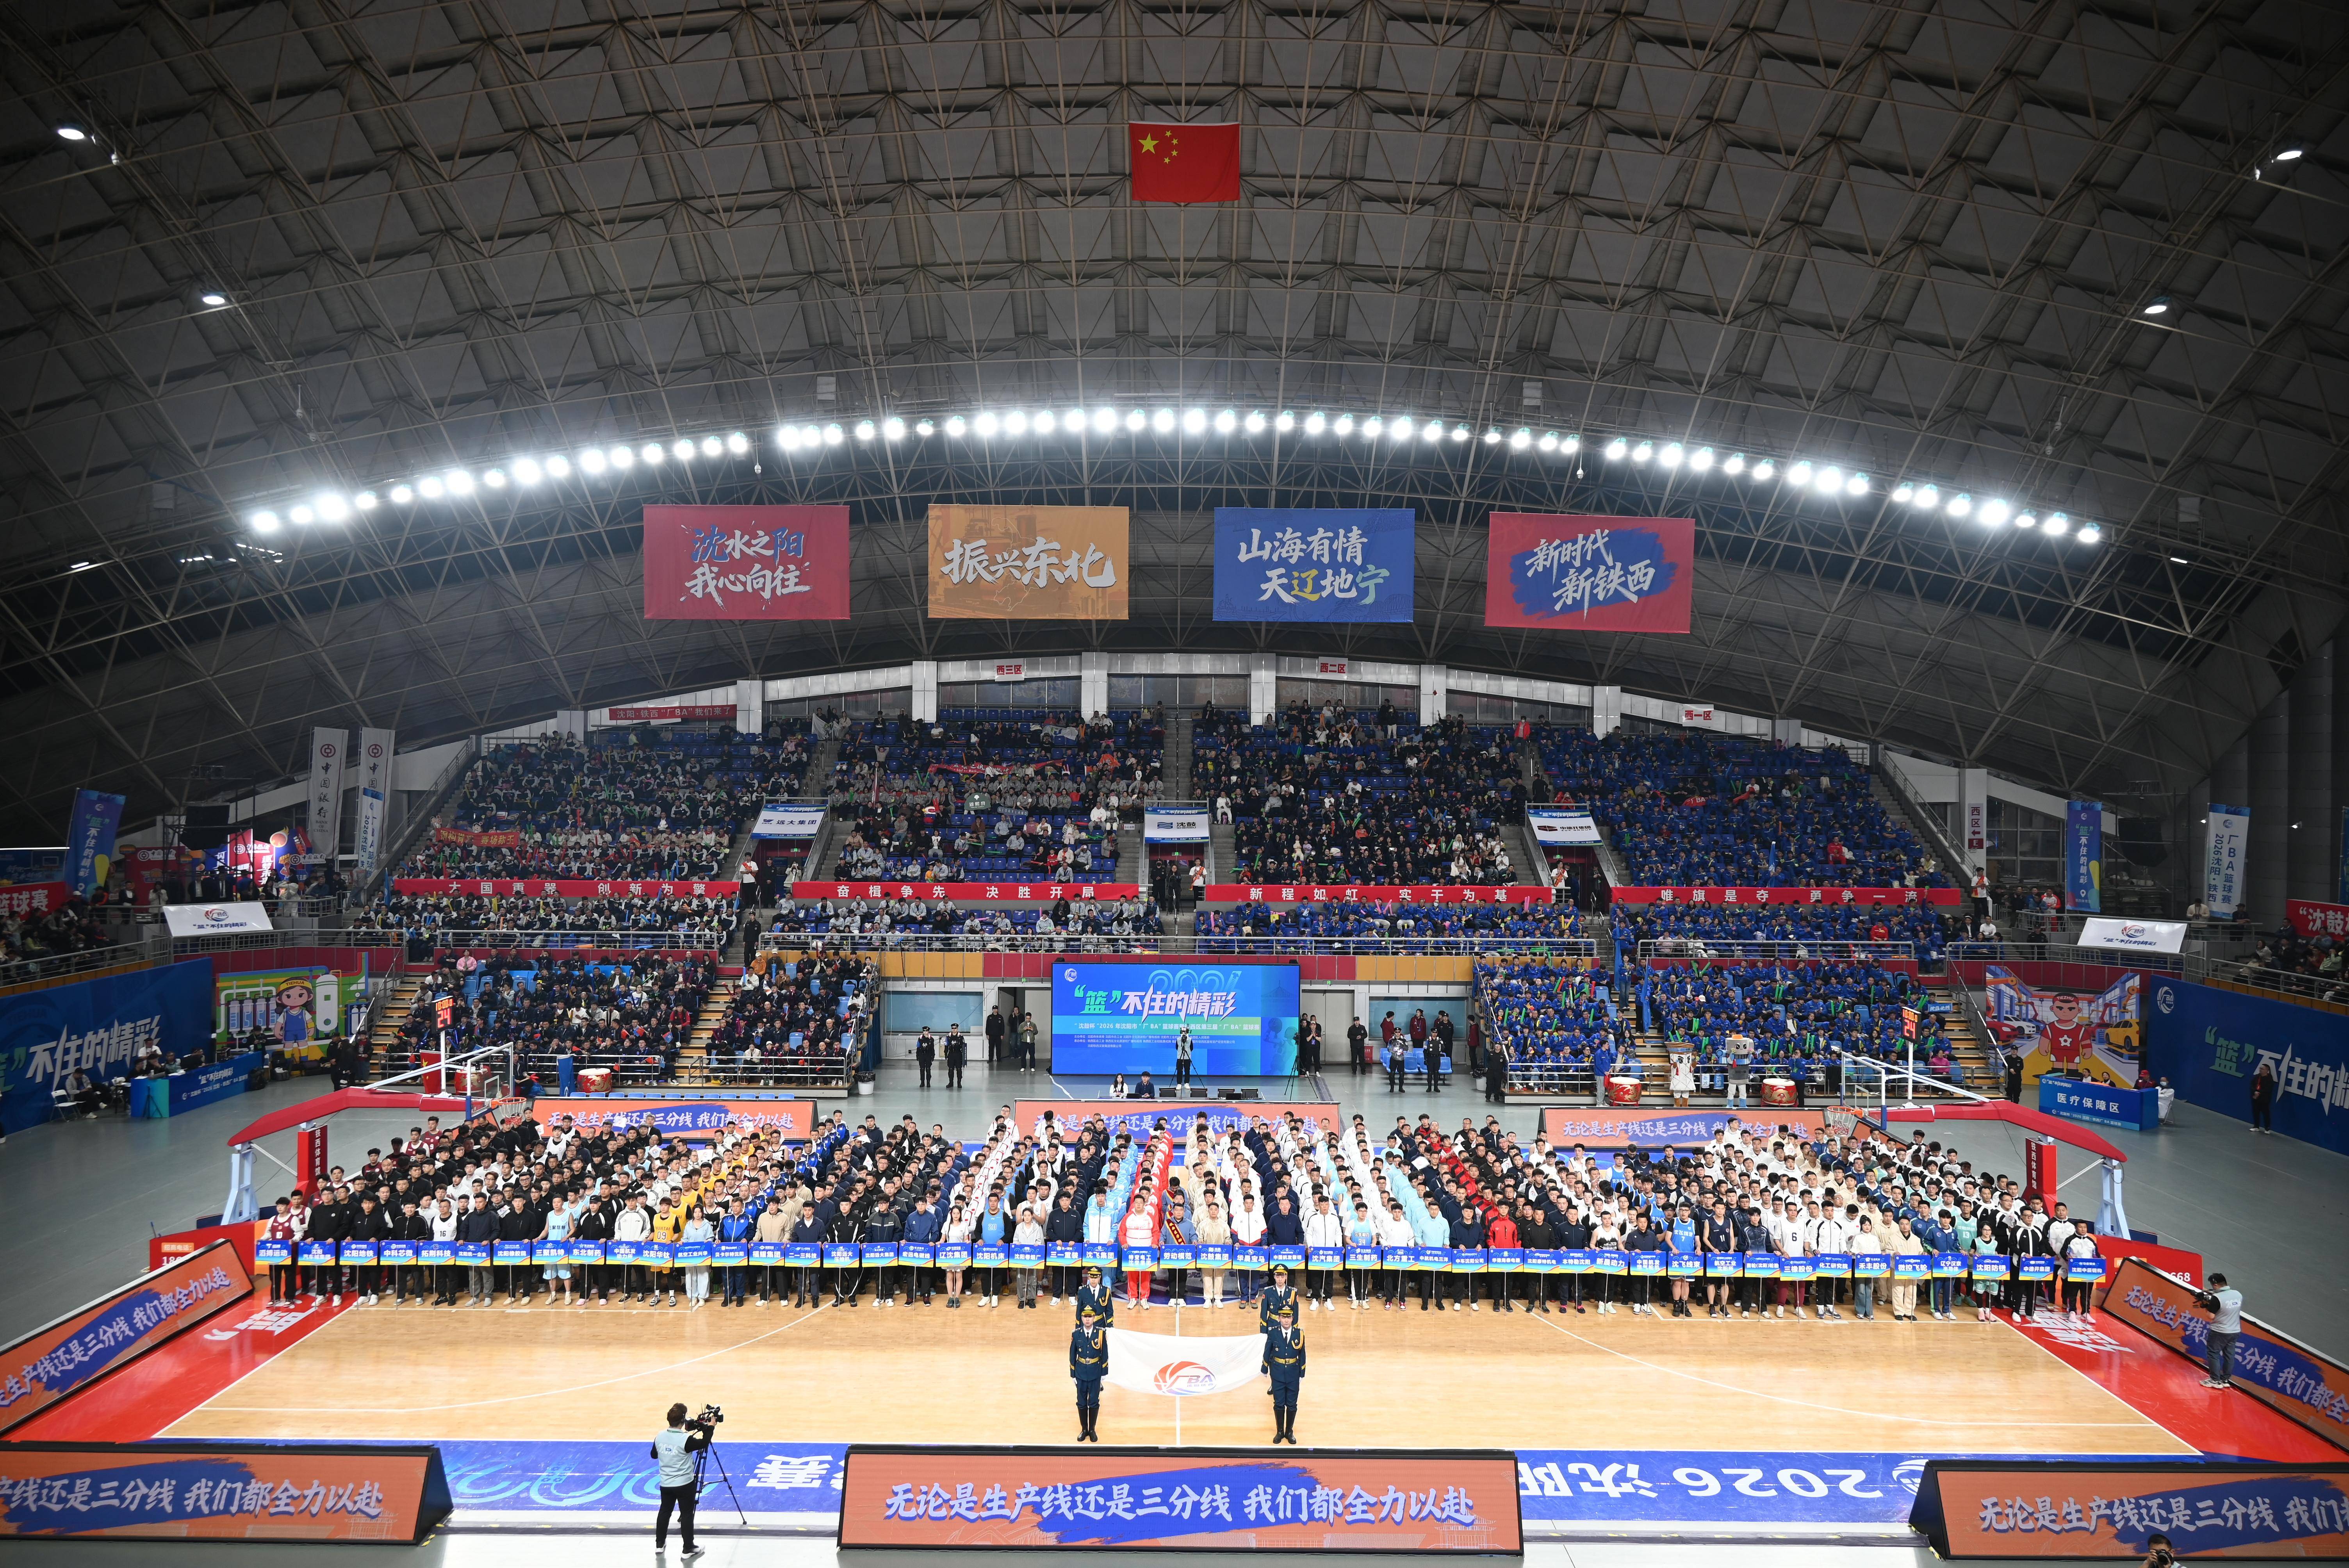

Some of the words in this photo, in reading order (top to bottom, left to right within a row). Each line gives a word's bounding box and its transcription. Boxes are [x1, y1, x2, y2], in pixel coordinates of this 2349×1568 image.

[690, 524, 804, 563] 沈水之阳
[1238, 526, 1369, 565] 山海有情
[941, 536, 1117, 590] 振兴东北
[1525, 528, 1613, 585] 新时代
[684, 563, 813, 612] 我心向往
[1260, 565, 1390, 605] 天辽地宁
[1552, 559, 1656, 620] 新铁西
[996, 664, 1022, 676] 西三区
[1319, 663, 1346, 674] 西二区
[1684, 709, 1713, 721] 西一区
[1971, 807, 1981, 828] 西区
[481, 835, 515, 845] 赛场称王
[448, 882, 557, 895] 大国重器
[837, 885, 945, 898] 奋楫争先
[986, 886, 1094, 898] 决胜开局
[1249, 887, 1358, 901] 新程如虹
[1399, 888, 1508, 902] 实干为基
[1660, 889, 1769, 902] 唯旗是夺
[1810, 890, 1918, 903] 勇争一流
[2299, 906, 2349, 936] “沈鼓
[2103, 937, 2157, 946] “篮”不住的精彩
[435, 999, 454, 1011] 10:00.0
[1074, 984, 1237, 1023] “篮”不住的精彩
[437, 1008, 451, 1028] 24
[1902, 1009, 1918, 1023] 10:00.0
[1904, 1019, 1916, 1039] 24
[2057, 1092, 2120, 1114] 医疗保障区
[1563, 1120, 1708, 1138] 无论是生产线还是三分线
[657, 1231, 667, 1240] 09
[1792, 1233, 1797, 1241] 6
[535, 1248, 565, 1257] 三聚凯特
[643, 1250, 670, 1259] 沈阳华钛
[1164, 1252, 1192, 1260] 劳动模范
[1237, 1254, 1265, 1263] 华晨宝马
[1596, 1258, 1625, 1267] 新晨动力
[132, 1266, 231, 1332] 我们都全力以赴
[2277, 1366, 2349, 1426] 我们都全
[1673, 1466, 1883, 1499] 2026
[183, 1479, 384, 1520] 我们都全力以赴
[884, 1481, 1232, 1523] 无论是生产线还是三分线
[1244, 1483, 1476, 1526] 我们都全力以赴
[1978, 1495, 2279, 1534] 无论是生产线还是三分线
